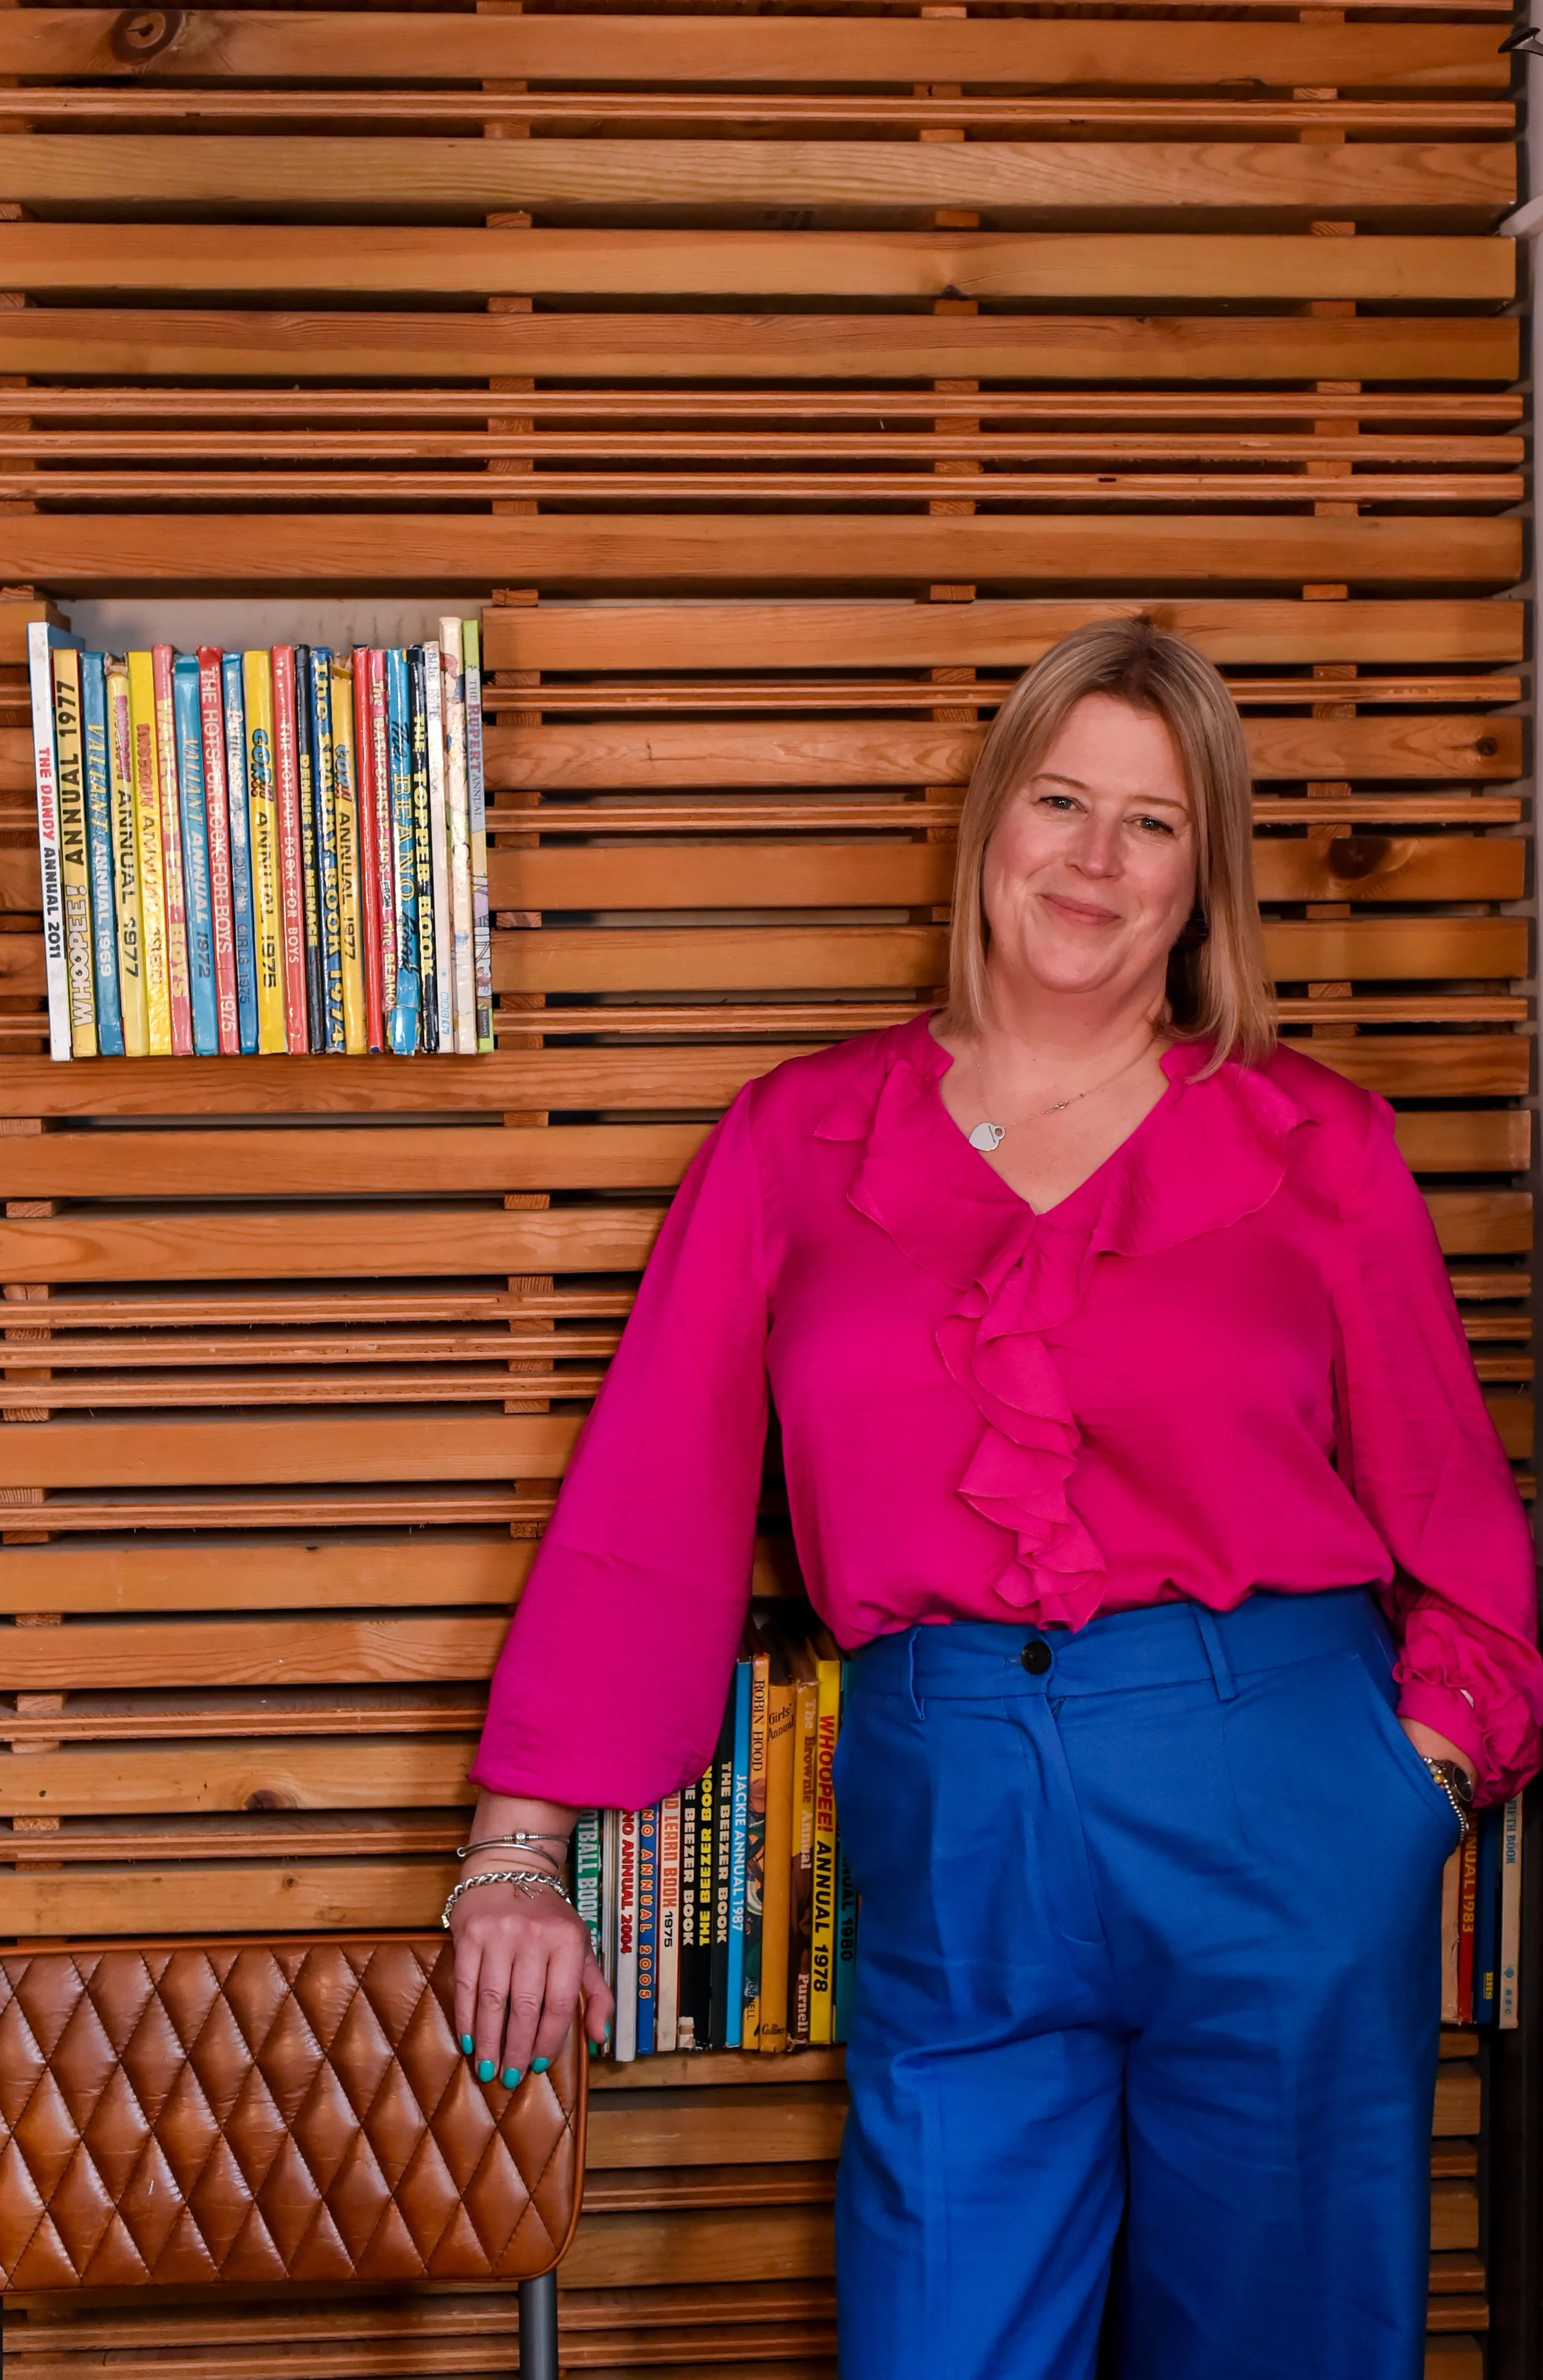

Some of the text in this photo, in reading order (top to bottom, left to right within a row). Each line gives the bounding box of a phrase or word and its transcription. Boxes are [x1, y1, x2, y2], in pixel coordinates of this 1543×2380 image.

[372, 679, 386, 707] The
[373, 717, 387, 762] BASH
[468, 679, 483, 819] THE RUPERT ANNUAL
[281, 757, 295, 828] HOTSPUR
[301, 754, 313, 825] DENNIS
[374, 768, 389, 829] STREET
[38, 747, 61, 959] THE DANDY ANNUAL 2011
[56, 680, 94, 1027] WHOOPEE! ANNUAL 1977
[88, 724, 112, 978] VALIANT ANNUAL 1969
[117, 789, 135, 904] ANNUAL
[156, 697, 189, 997] WARLORD FOR BOYS
[183, 738, 212, 979] VALIANT ANNUAL 1972
[201, 666, 220, 704] THE
[220, 992, 236, 1032] 1975
[256, 812, 274, 923] ANNUAL
[284, 836, 296, 880] BOOK
[339, 812, 353, 905] ANNUAL
[377, 838, 391, 874] KIDS
[393, 773, 415, 901] BEANO
[413, 714, 433, 976] THE TOPPER BOOK
[286, 888, 298, 917] FOR
[305, 869, 318, 947] MENACE
[323, 868, 341, 955] BOOK
[381, 919, 395, 946] The
[123, 917, 139, 978] 1977
[236, 923, 250, 965] GIRLS
[261, 935, 277, 988] 1975
[287, 927, 299, 963] BOYS
[343, 917, 356, 960] 1977
[238, 972, 251, 1004] 1975
[330, 969, 344, 1042] 1974
[383, 953, 397, 1005] BEANO
[752, 1679, 765, 1772] ROBIN HOOD
[767, 1715, 794, 1742] Annual
[800, 1699, 818, 1870] The Brownie Annual
[663, 1815, 678, 1862] LEARN
[683, 1807, 696, 1883] BEEZER
[700, 1828, 712, 1903] BEEZER
[717, 1762, 732, 1944] THE BEEZER BOOK
[731, 1774, 747, 1932] JACKIE ANNUAL 1987
[813, 1715, 836, 1993] WHOOPEE! ANNUAL 1978
[1506, 1835, 1516, 1865] BOOK
[577, 1877, 597, 1923] BOOK
[621, 1839, 634, 1910] ANNUAL
[638, 1809, 654, 1999] NO ANNUAL 2005
[663, 1867, 678, 1907] BOOK
[620, 1914, 633, 1954] 2004
[664, 1911, 673, 1947] 1975
[683, 1889, 694, 1946] BOOK
[699, 1910, 710, 1946] THE
[841, 1917, 854, 1962] 1980
[1462, 1894, 1475, 1933] 1983
[797, 1973, 810, 2033] Purnell
